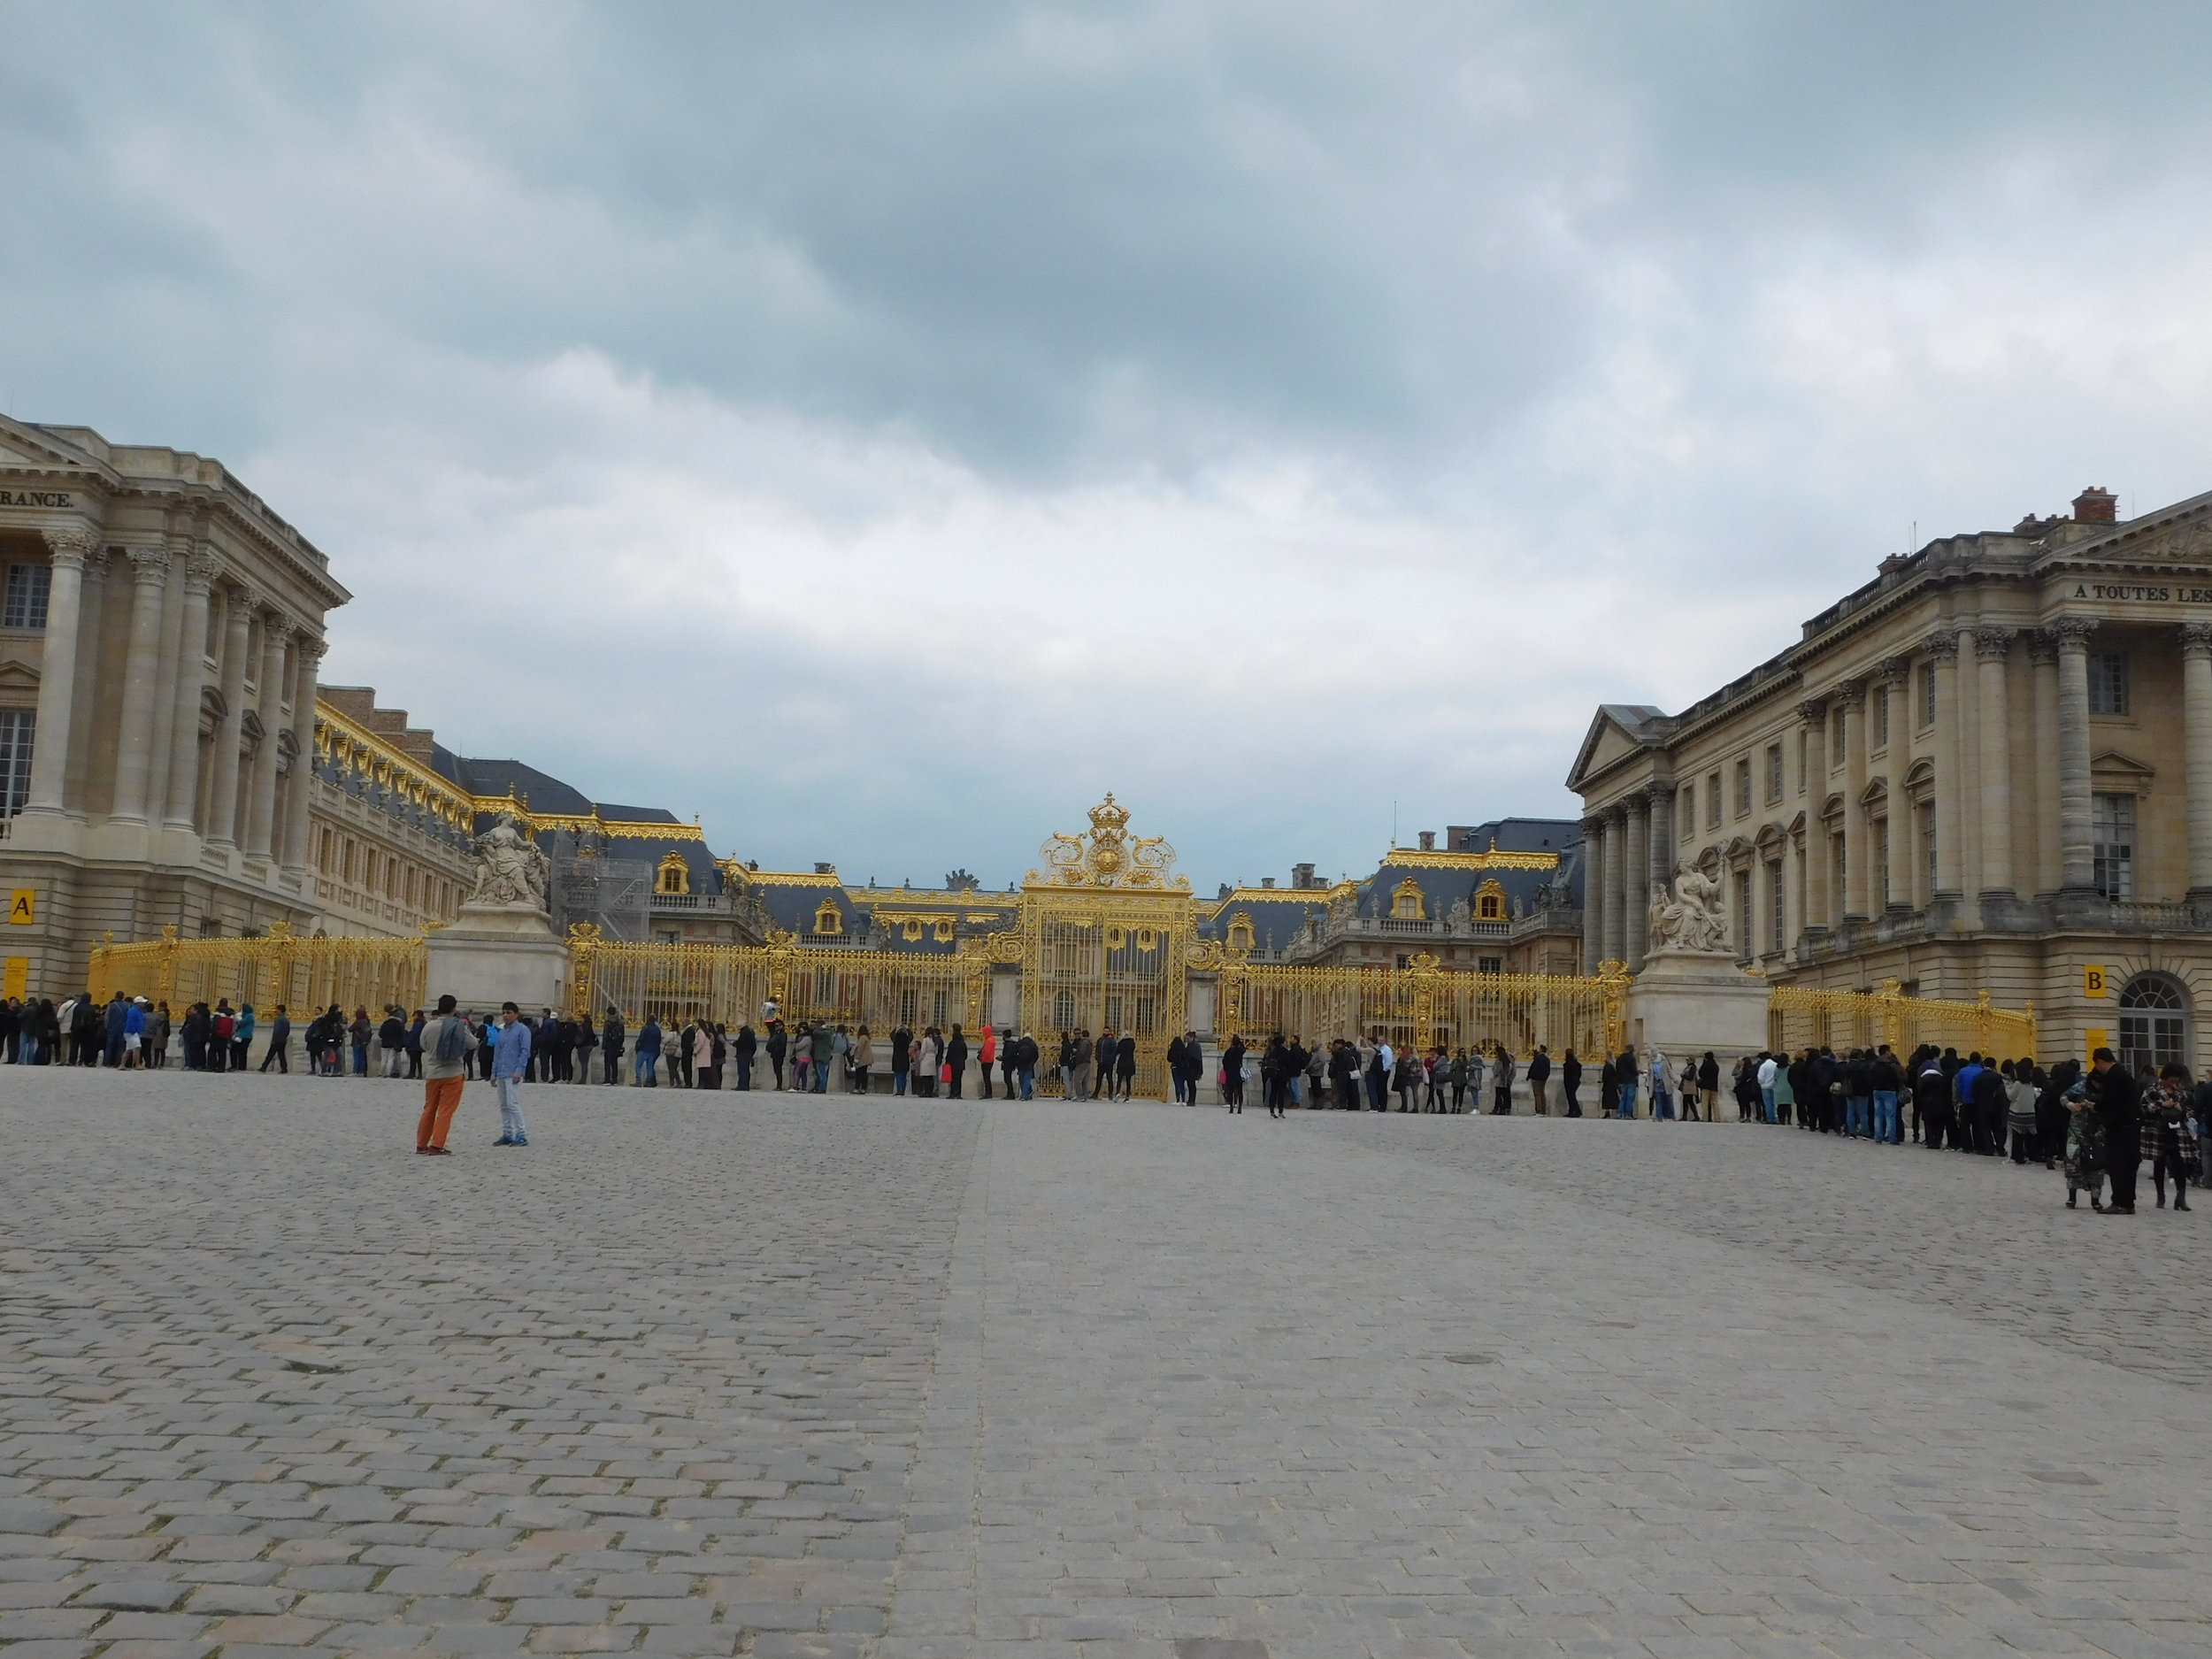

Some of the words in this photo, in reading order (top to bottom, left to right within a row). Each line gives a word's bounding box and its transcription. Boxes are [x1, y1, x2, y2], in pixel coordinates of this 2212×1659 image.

[0, 490, 73, 507] RANCE.
[2074, 584, 2087, 598] A
[2093, 585, 2170, 601] TOUTES
[2177, 588, 2212, 603] LES
[12, 896, 29, 915] A
[2088, 972, 2102, 989] B
